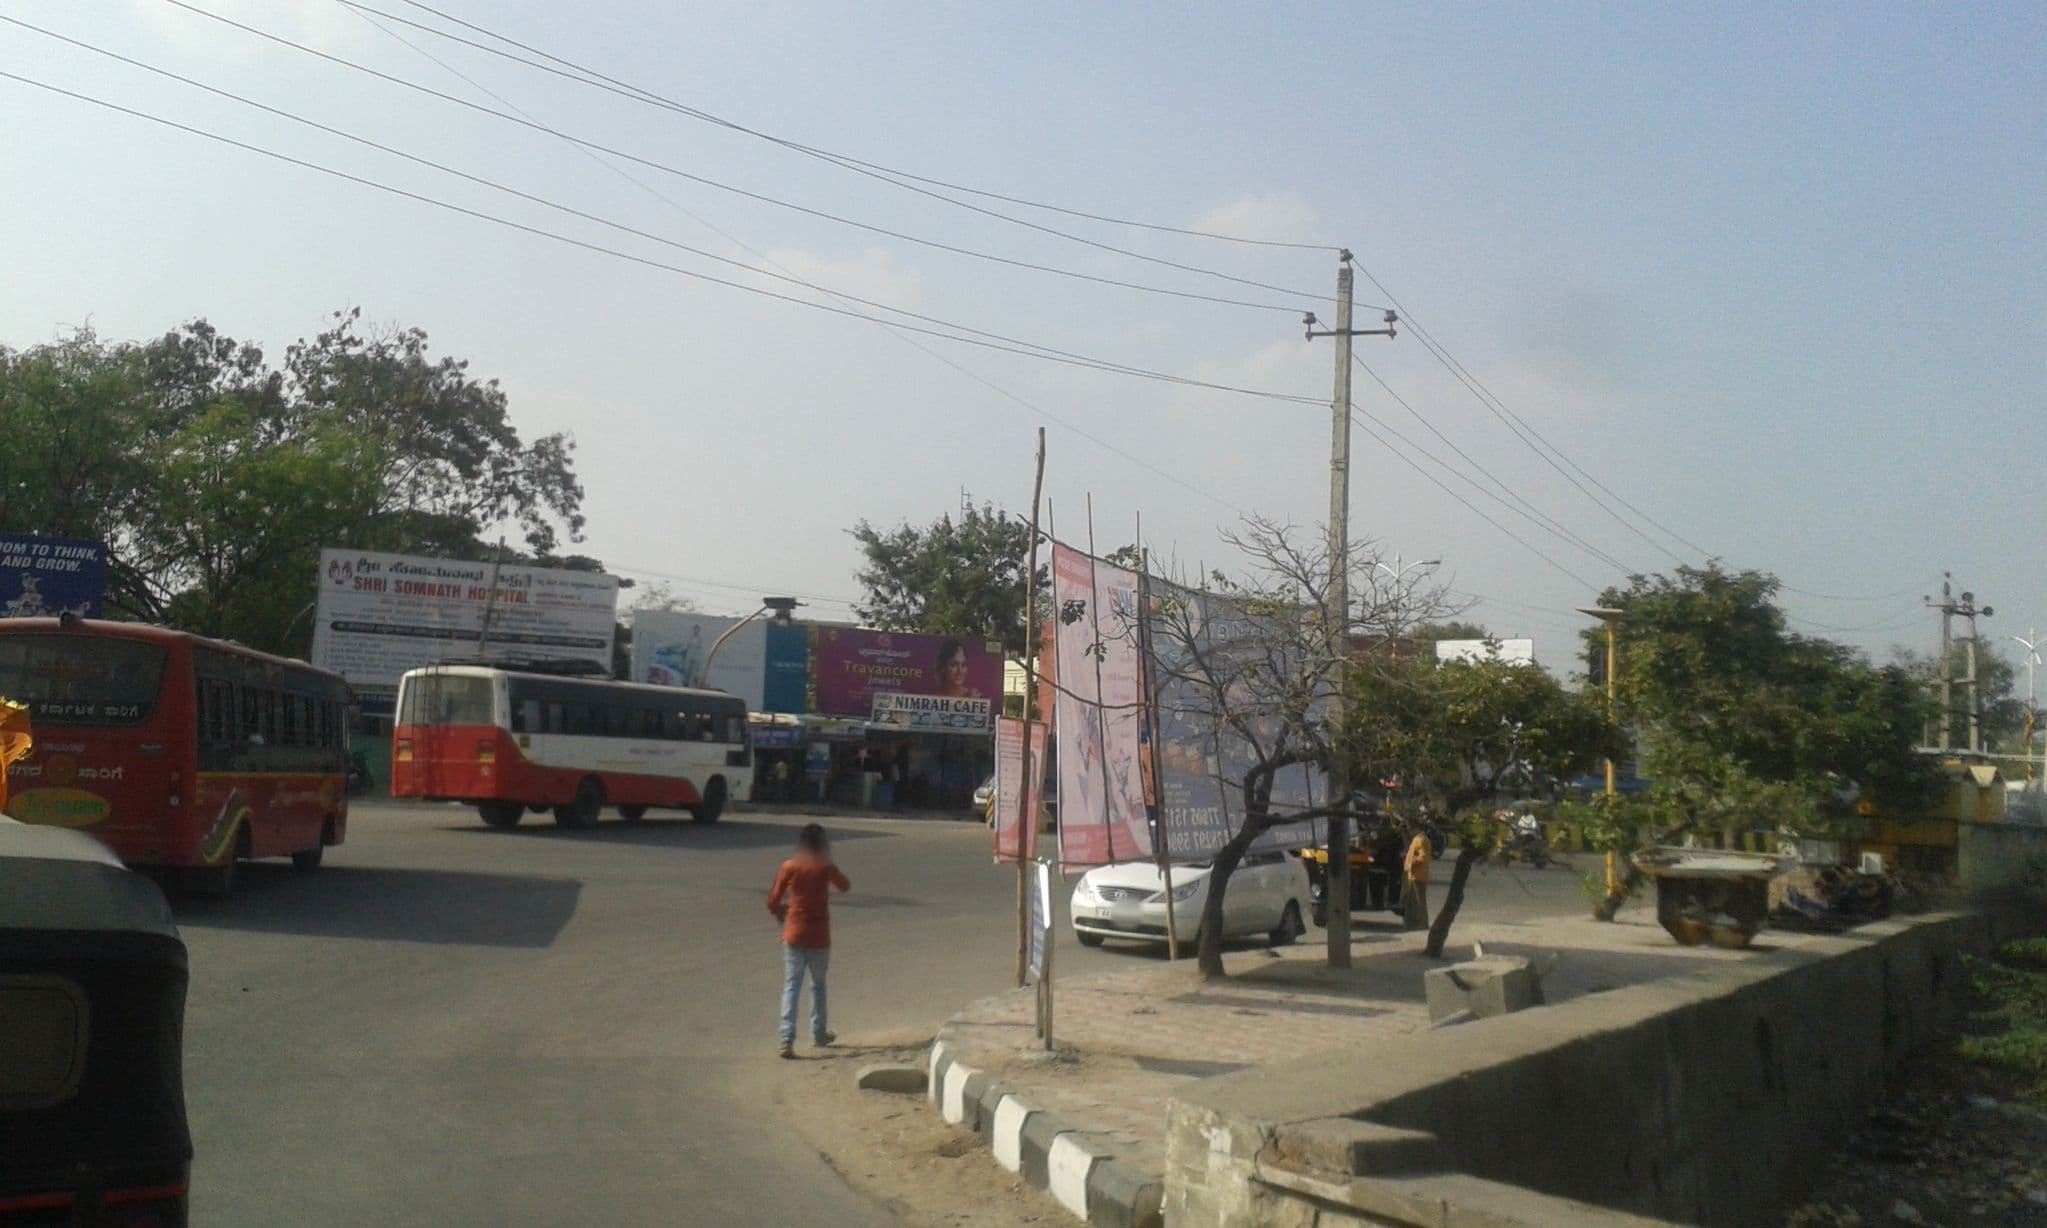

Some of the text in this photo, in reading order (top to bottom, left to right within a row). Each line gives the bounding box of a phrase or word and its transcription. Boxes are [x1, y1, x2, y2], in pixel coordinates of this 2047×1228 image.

[31, 543, 50, 556] TO
[53, 545, 98, 562] THINK,
[1, 555, 81, 572] AND GROW.
[352, 576, 388, 593] SHRI
[394, 579, 462, 599] SOMNATH
[843, 660, 923, 678] Travancore
[895, 695, 949, 711] NIMRAH
[953, 699, 988, 714] CAFE
